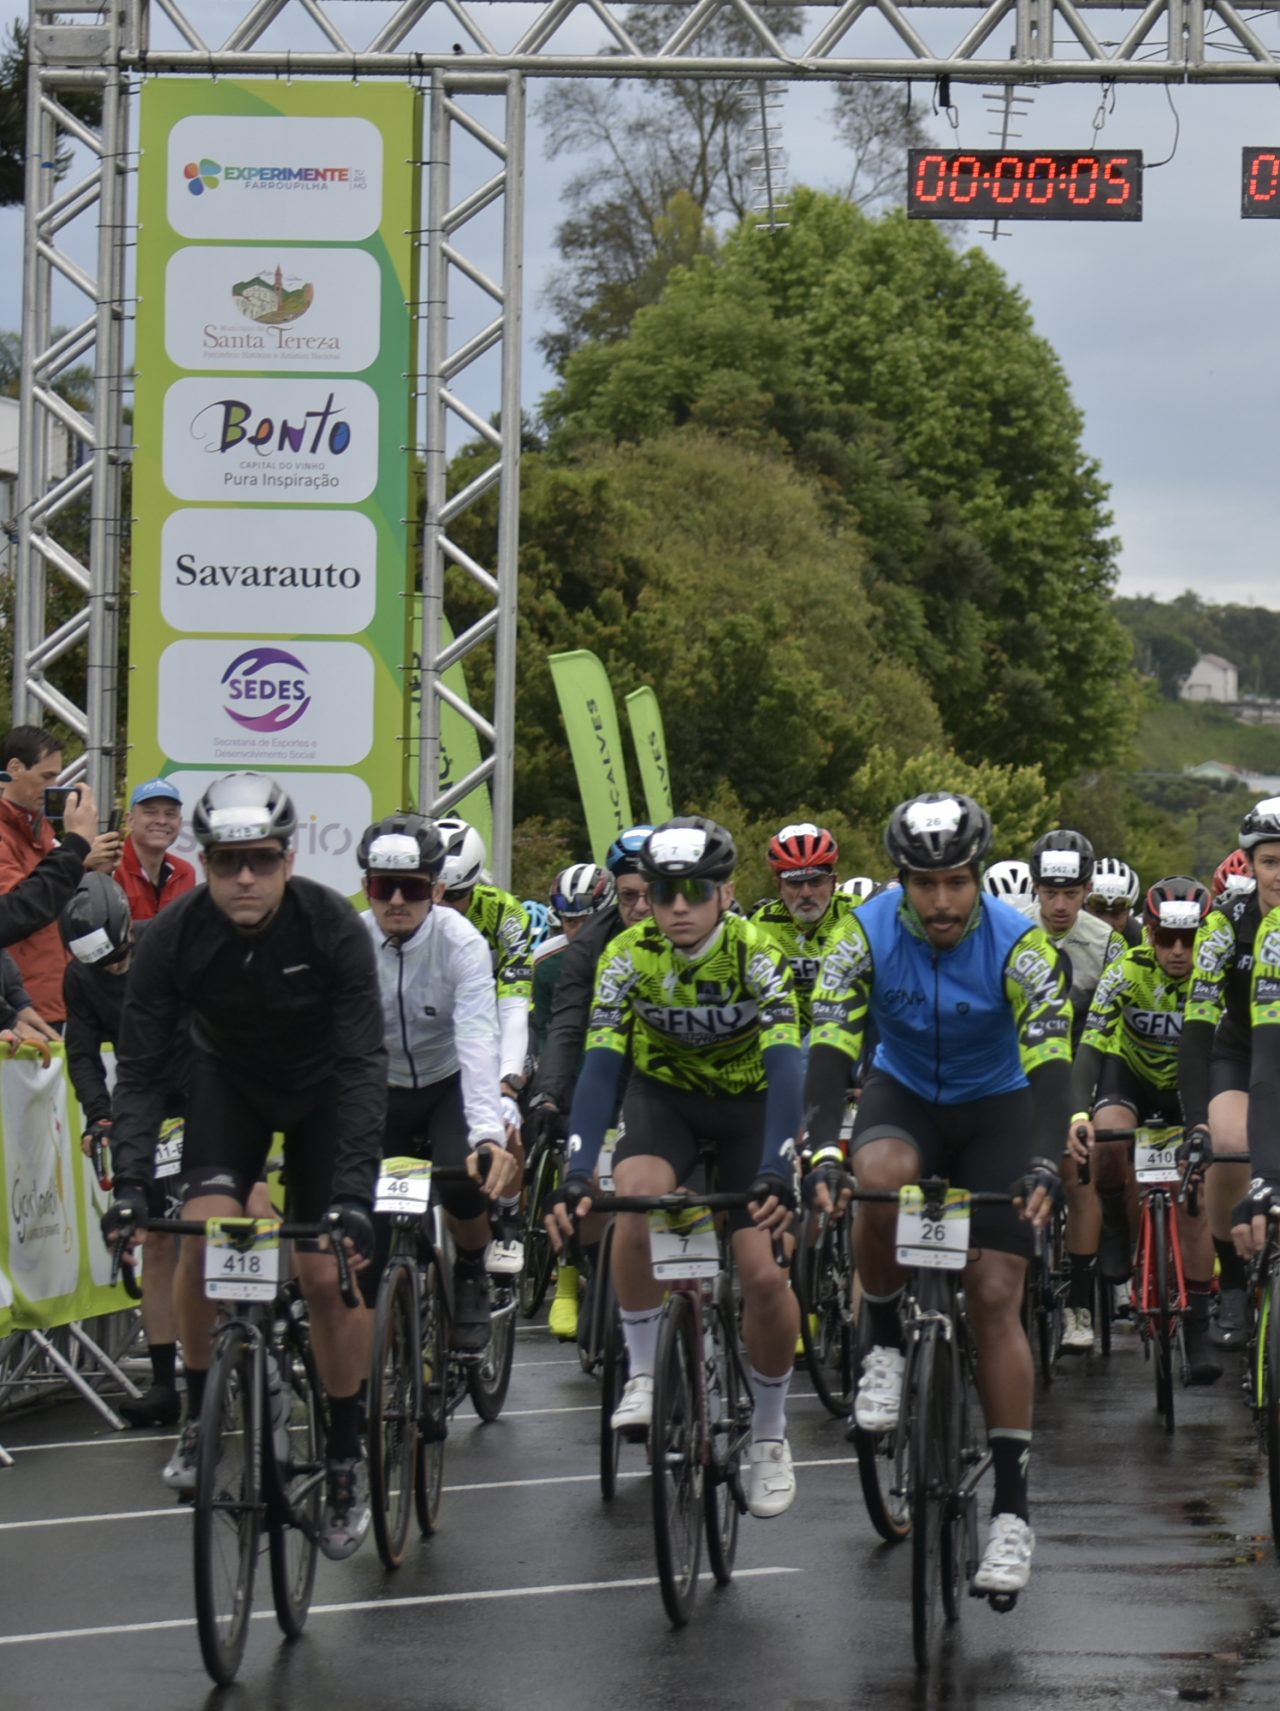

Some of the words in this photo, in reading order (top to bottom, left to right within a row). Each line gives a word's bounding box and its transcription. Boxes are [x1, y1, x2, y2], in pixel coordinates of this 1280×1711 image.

[224, 167, 349, 181] EXPERIMENTE
[916, 155, 1131, 205] 00:00:05
[244, 181, 328, 190] FARROUPILHA
[203, 323, 265, 349] Santa
[267, 325, 341, 350] Tereza
[240, 462, 276, 471] CAPITAL
[280, 462, 293, 471] DO
[296, 462, 326, 471] VINHO
[224, 472, 258, 486] Pura
[263, 473, 341, 490] Inspiração
[175, 554, 362, 589] Savarauto
[228, 679, 307, 701] SEDES
[645, 1004, 743, 1034] GFNY
[1147, 1151, 1173, 1163] 410
[387, 1180, 409, 1194] 46
[921, 1223, 946, 1242] 26
[678, 1238, 690, 1253] 7
[223, 1255, 261, 1273] 418
